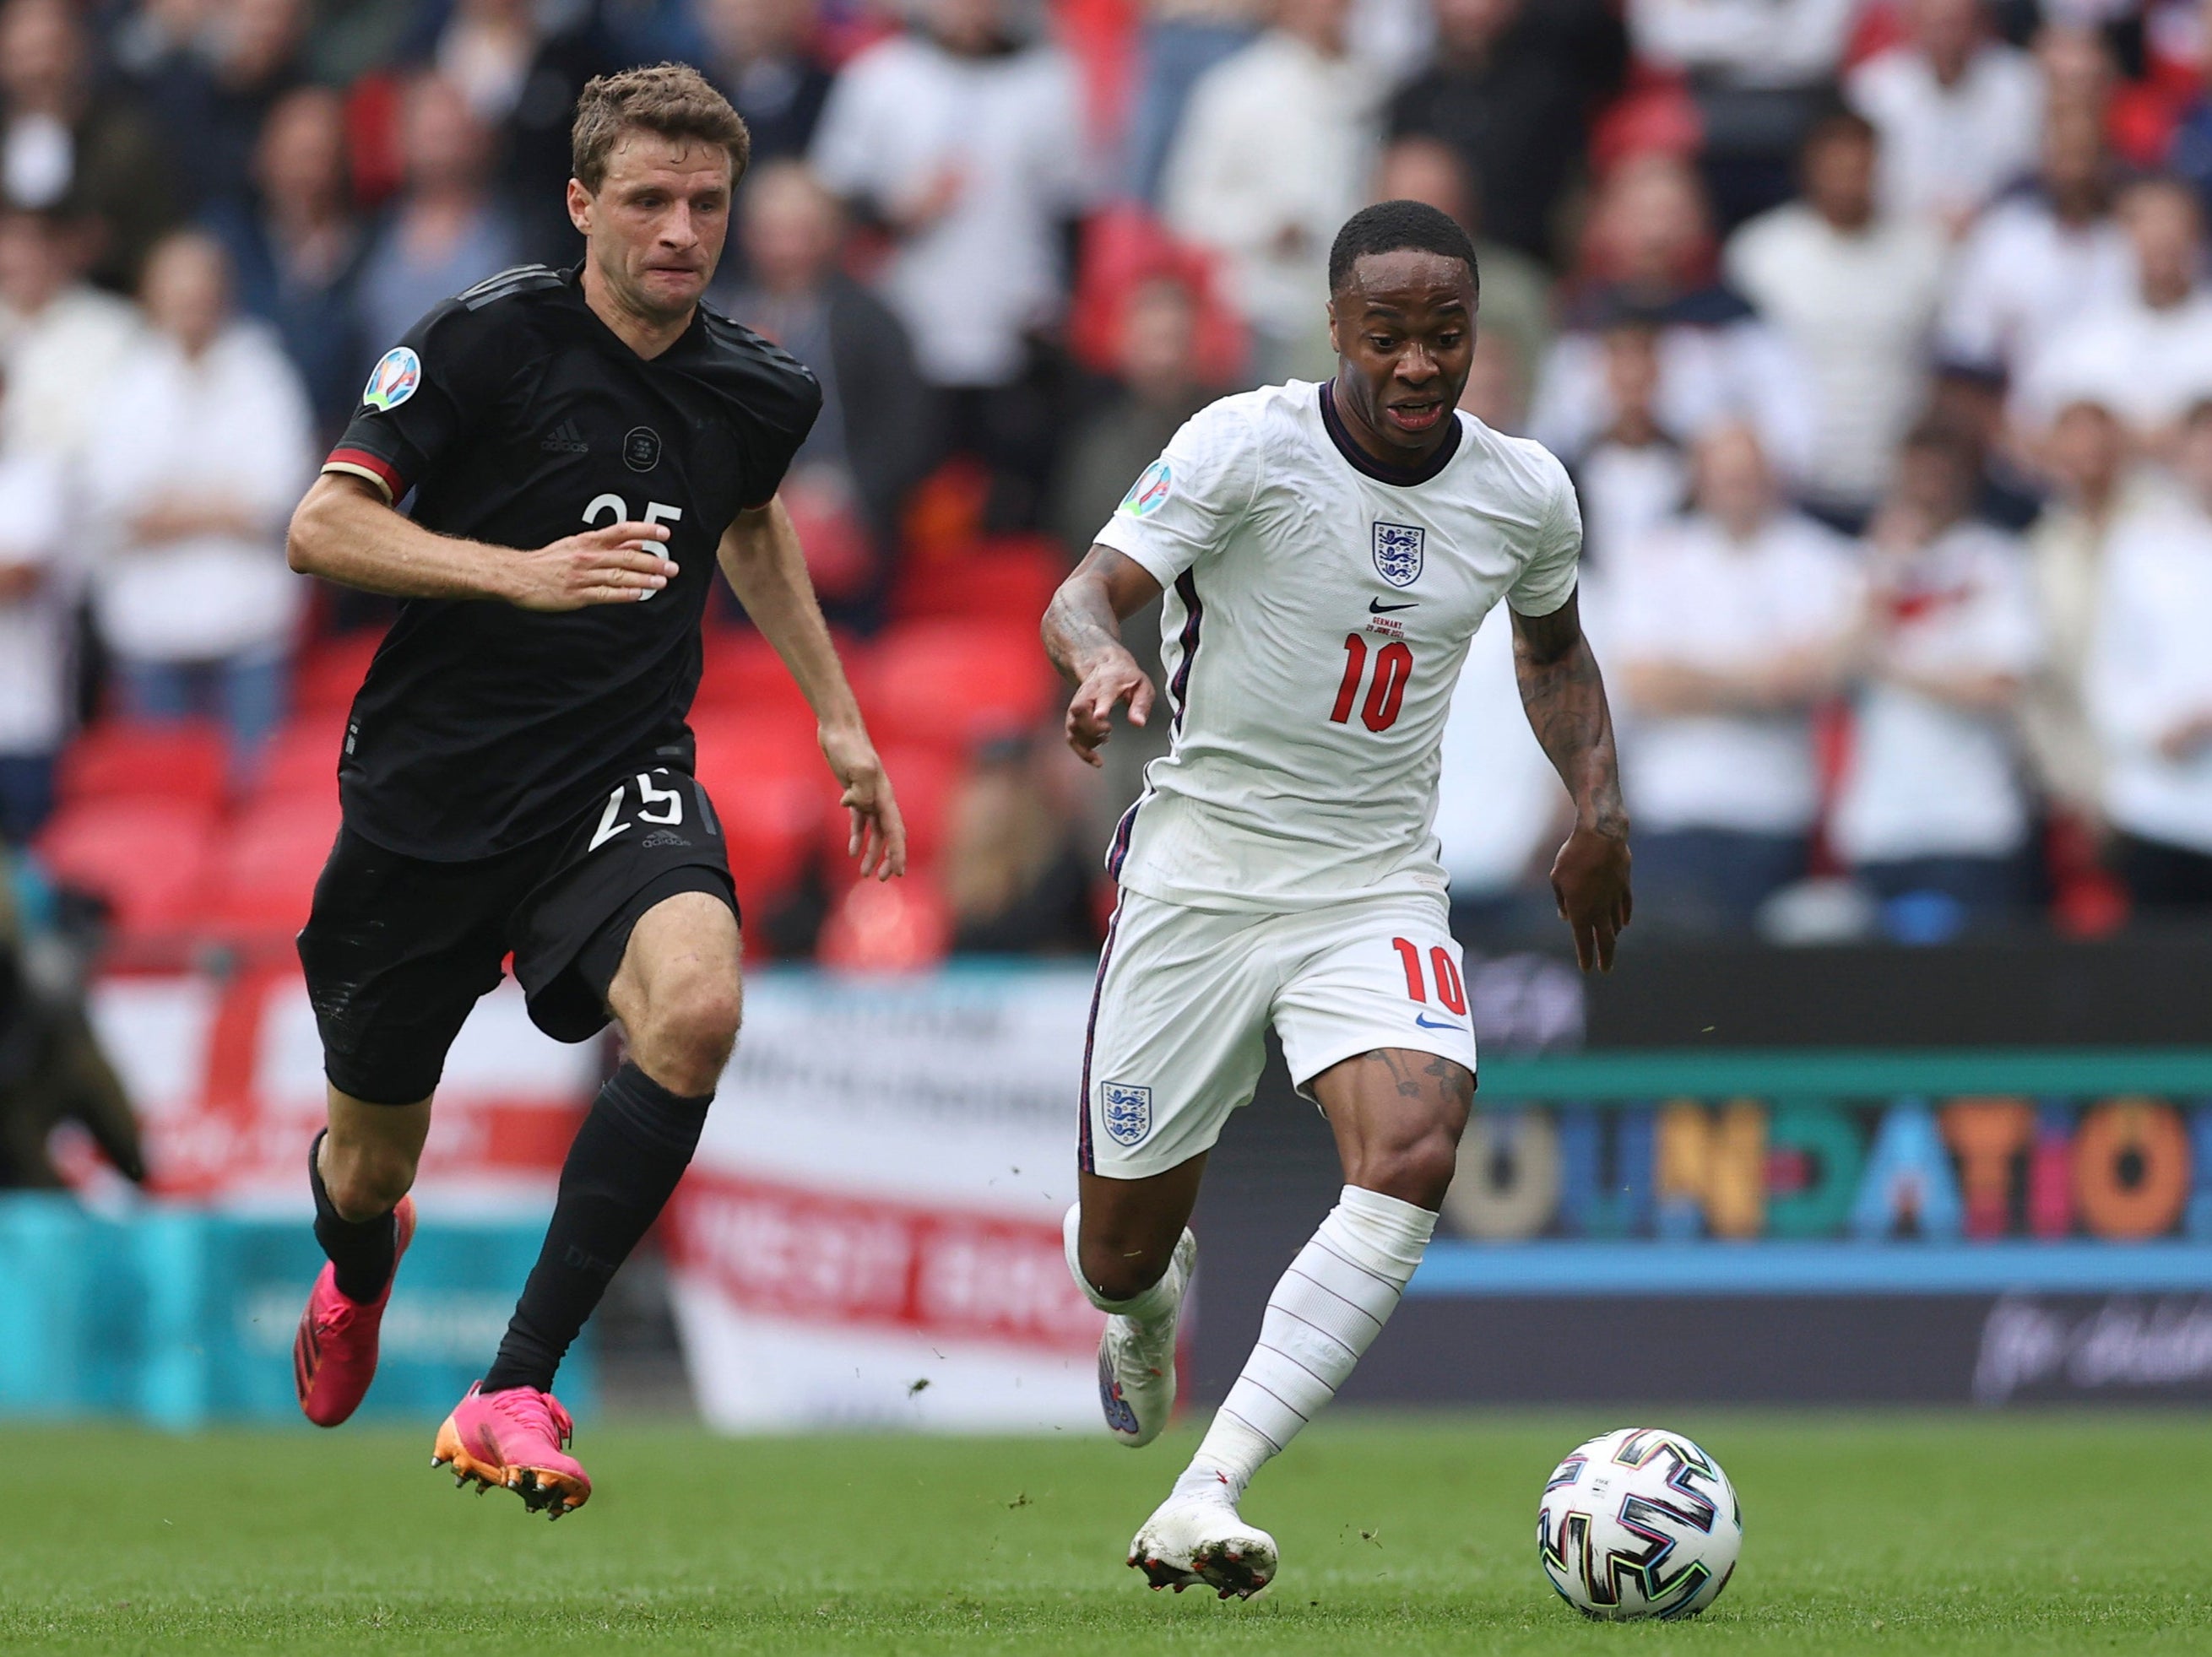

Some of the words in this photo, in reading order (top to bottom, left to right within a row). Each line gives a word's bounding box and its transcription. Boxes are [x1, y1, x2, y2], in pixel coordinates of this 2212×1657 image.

[540, 439, 589, 453] adidas
[1373, 616, 1402, 629] GERMANY
[1374, 626, 1391, 636] JUNE
[1391, 630, 1404, 638] 2021
[1330, 632, 1413, 733] 10
[642, 837, 691, 848] adidas
[1392, 937, 1467, 1016] 10
[1450, 1097, 2212, 1245] OUNDATIO
